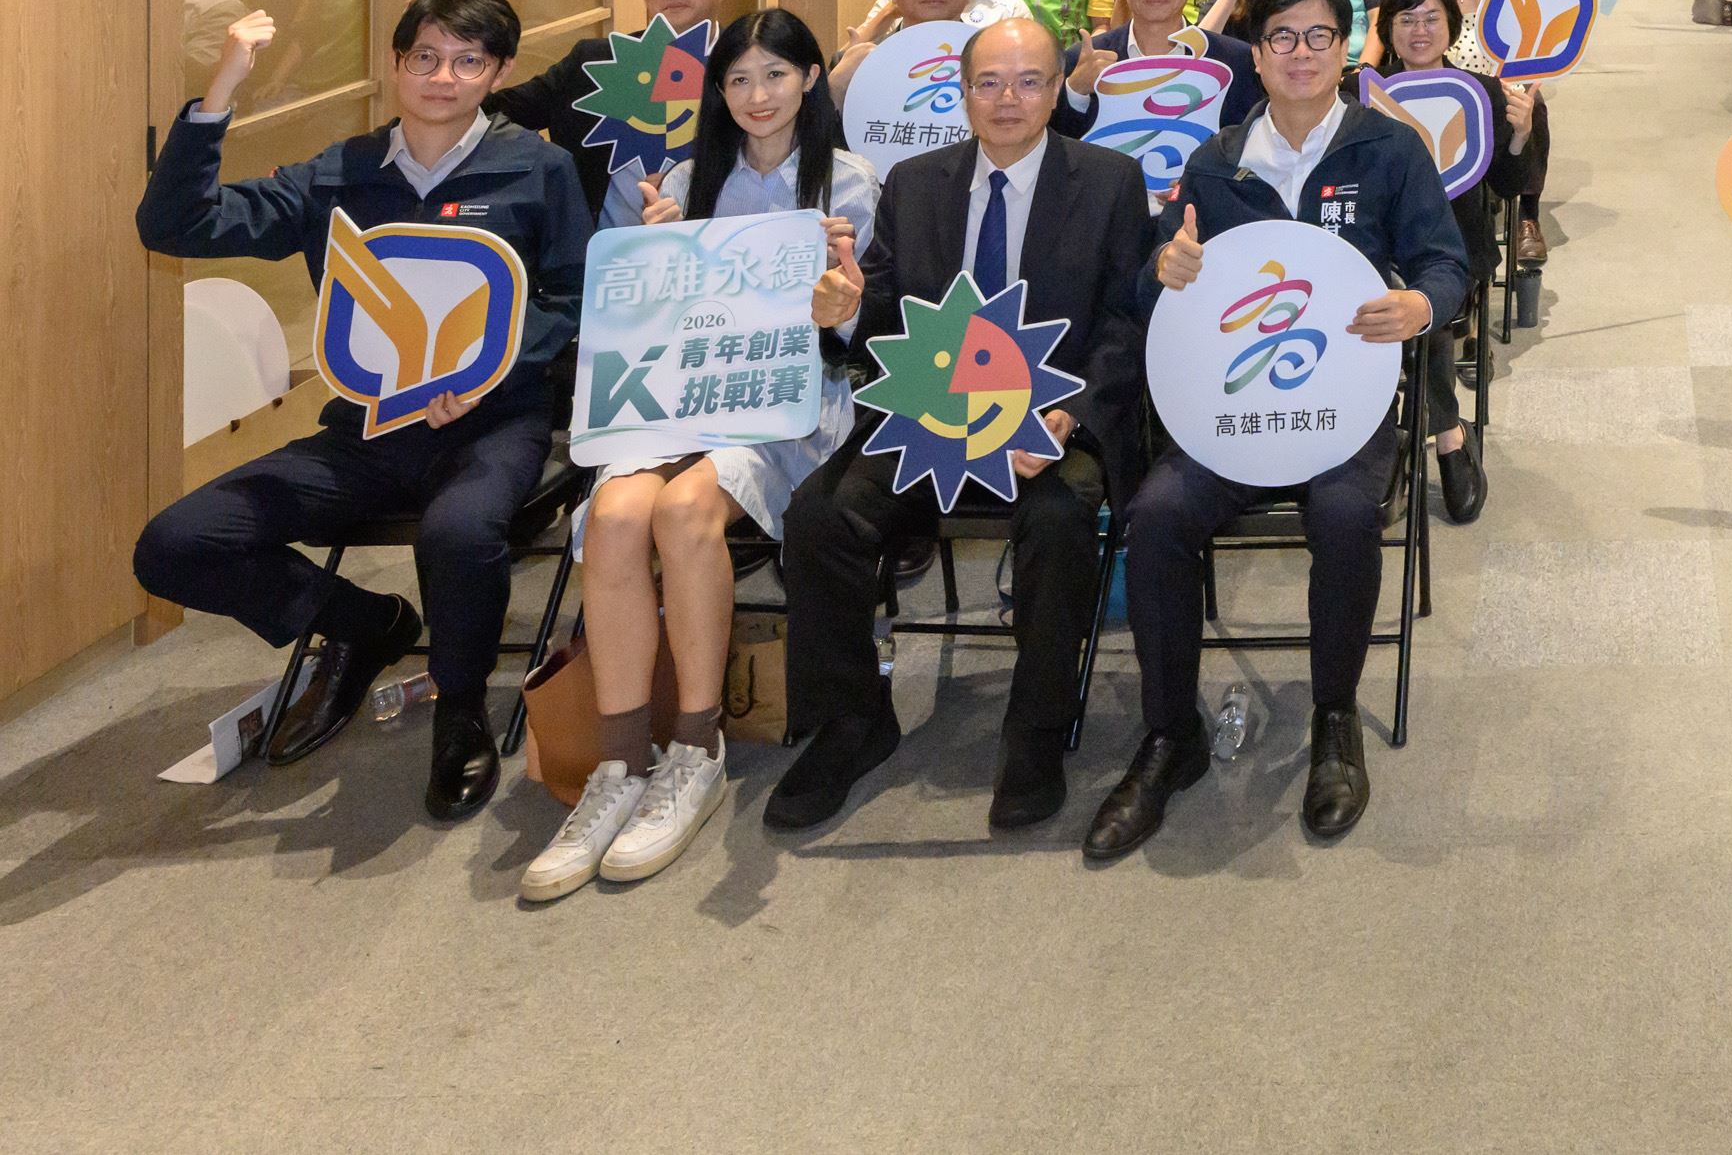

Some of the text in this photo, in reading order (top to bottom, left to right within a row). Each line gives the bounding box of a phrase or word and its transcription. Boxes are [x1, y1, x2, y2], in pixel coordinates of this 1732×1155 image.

[863, 119, 974, 147] 高雄市政
[1344, 200, 1357, 225] 市長
[594, 241, 820, 310] 高雄永續
[683, 312, 726, 331] 2026
[679, 323, 813, 370] 青年創業
[674, 364, 810, 419] 挑戰賽
[1215, 407, 1338, 437] 高雄市政府
